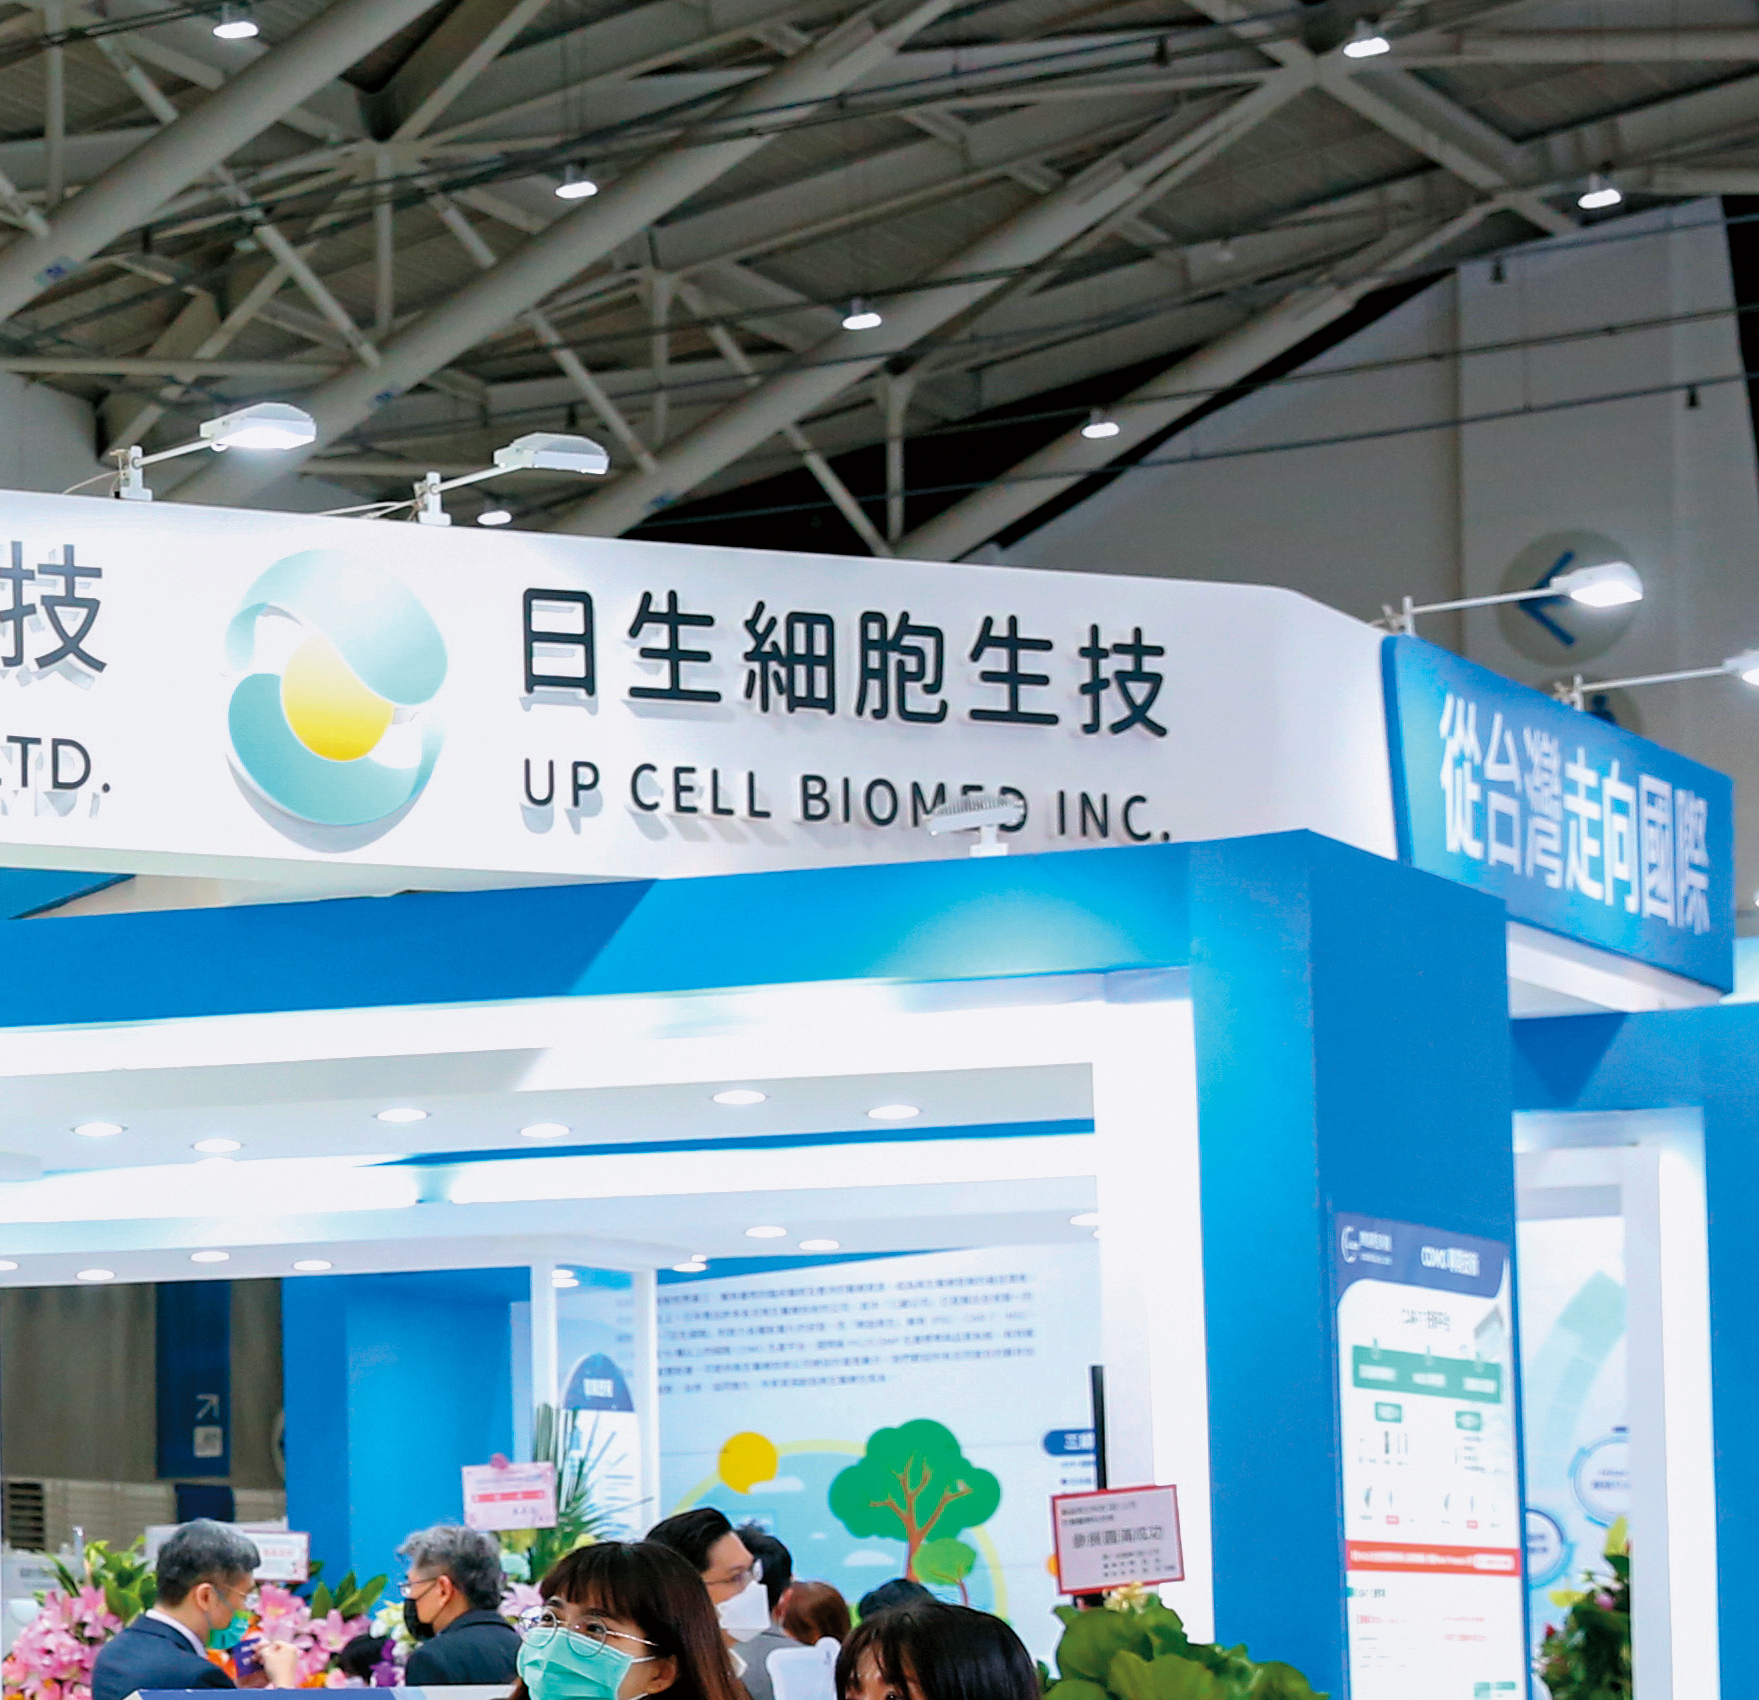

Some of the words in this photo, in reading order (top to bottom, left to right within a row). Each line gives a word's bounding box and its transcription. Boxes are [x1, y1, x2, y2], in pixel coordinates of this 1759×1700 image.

[522, 587, 1168, 739] 日生細胞生技
[523, 758, 600, 808] UP
[630, 762, 772, 820] CELL
[1057, 789, 1173, 845] INC.
[1439, 692, 1710, 936] 從台灣走向國際
